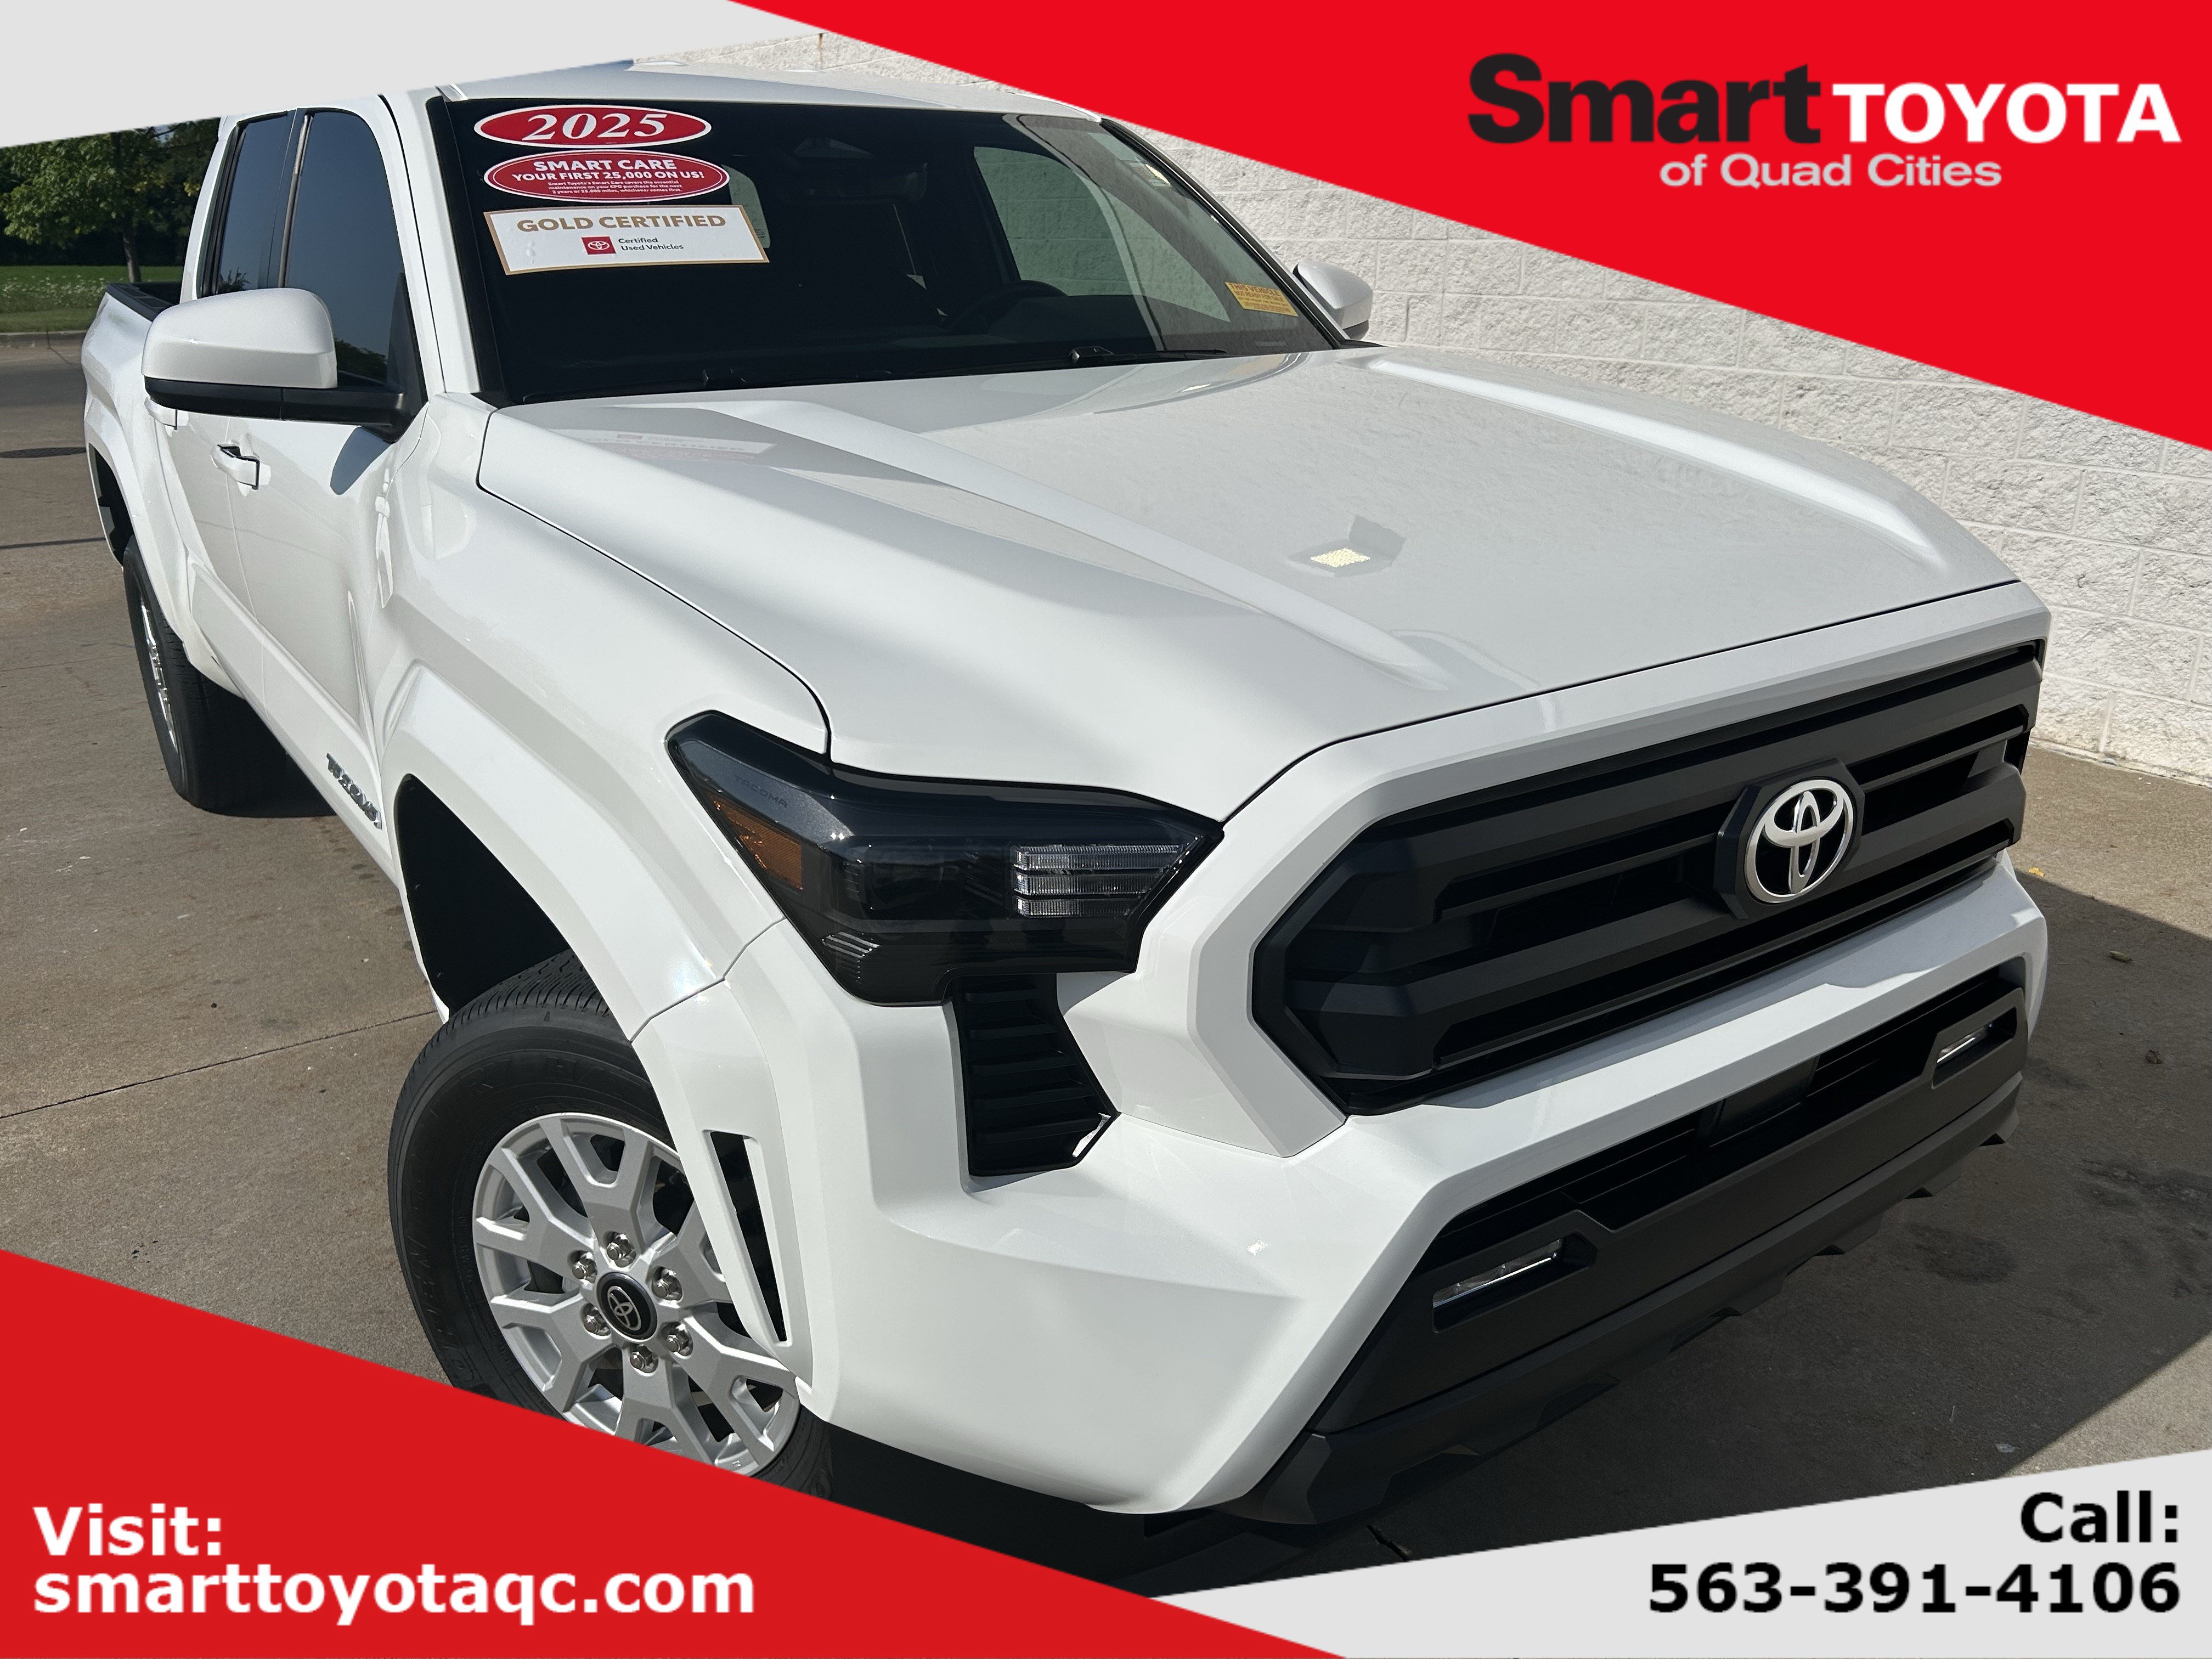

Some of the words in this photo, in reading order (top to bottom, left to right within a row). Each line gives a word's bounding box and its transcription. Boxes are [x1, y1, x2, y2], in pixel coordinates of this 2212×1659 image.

[522, 112, 667, 141] 2025
[534, 160, 612, 171] SMART
[618, 160, 677, 170] CARE
[512, 173, 558, 182] YOUR
[559, 172, 600, 180] FIRST
[603, 171, 652, 180] 25,000
[517, 217, 594, 232] GOLD
[599, 215, 726, 228] CERTIFIED
[733, 774, 789, 809] TACOMA
